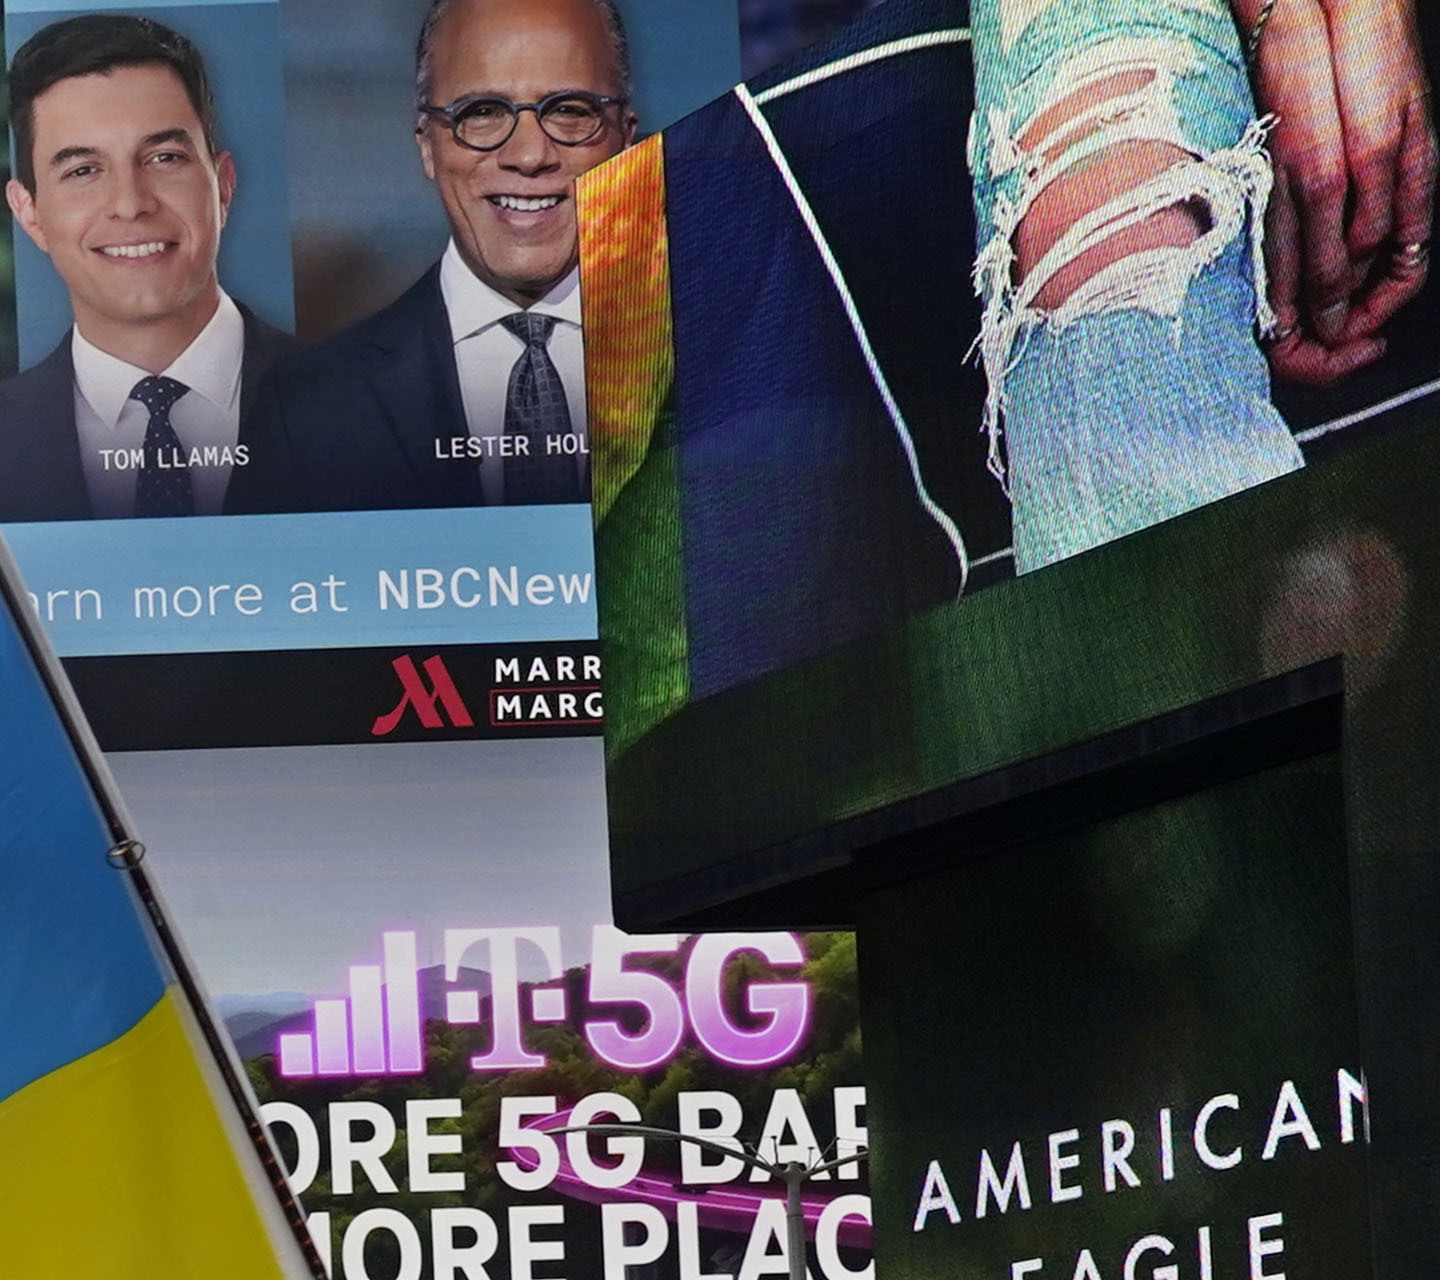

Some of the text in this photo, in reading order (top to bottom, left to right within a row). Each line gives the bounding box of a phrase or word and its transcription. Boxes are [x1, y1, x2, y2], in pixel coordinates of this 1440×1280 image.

[100, 444, 250, 471] TOM LLAMAS
[434, 435, 530, 460] LESTER
[133, 573, 349, 621] more at
[584, 925, 808, 1069] 5G
[496, 1092, 646, 1192] 5G
[913, 1065, 1371, 1233] AMERICAN
